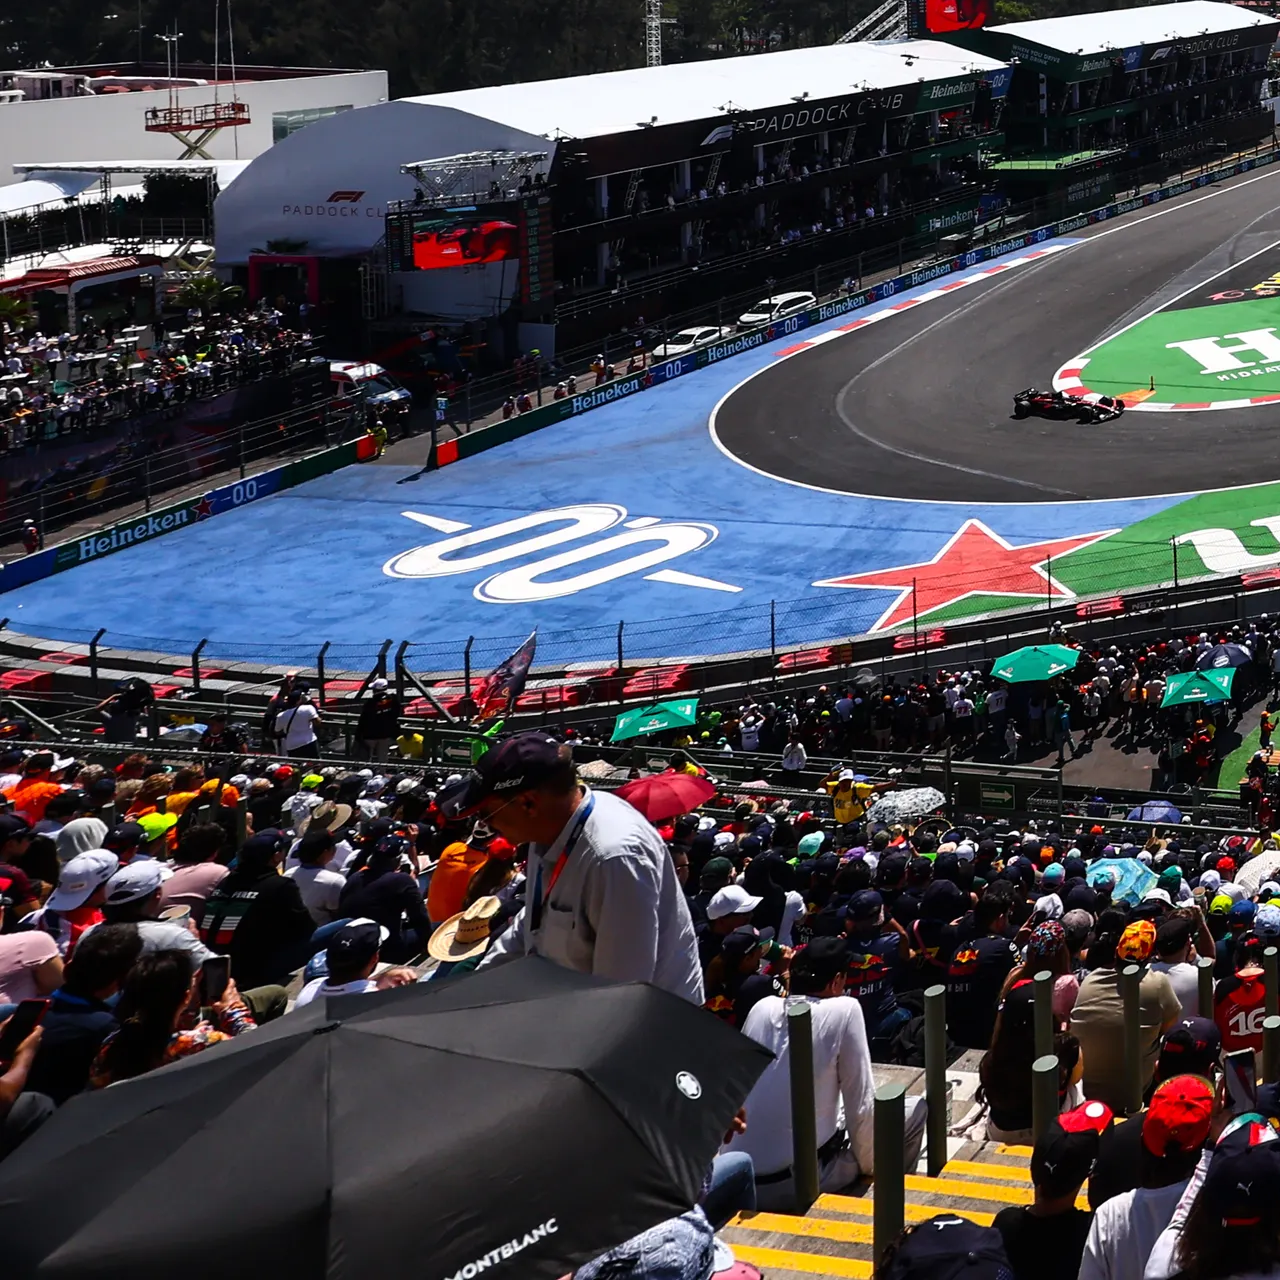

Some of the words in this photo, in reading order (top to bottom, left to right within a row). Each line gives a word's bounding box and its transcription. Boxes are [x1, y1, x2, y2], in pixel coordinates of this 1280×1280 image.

[1216, 34, 1239, 48] CLUB
[931, 80, 975, 98] Heineken
[283, 205, 358, 217] PADDOCK
[1059, 216, 1088, 233] Heineken
[990, 237, 1024, 257] Heineken
[911, 264, 950, 286] Heineken
[819, 295, 865, 320] Heineken
[708, 332, 763, 362] Heineken
[572, 379, 639, 413] Heineken
[79, 508, 188, 560] Heineken
[493, 775, 524, 792] telcel
[1229, 1007, 1266, 1036] 16
[444, 1218, 559, 1280] MONTBLANC
